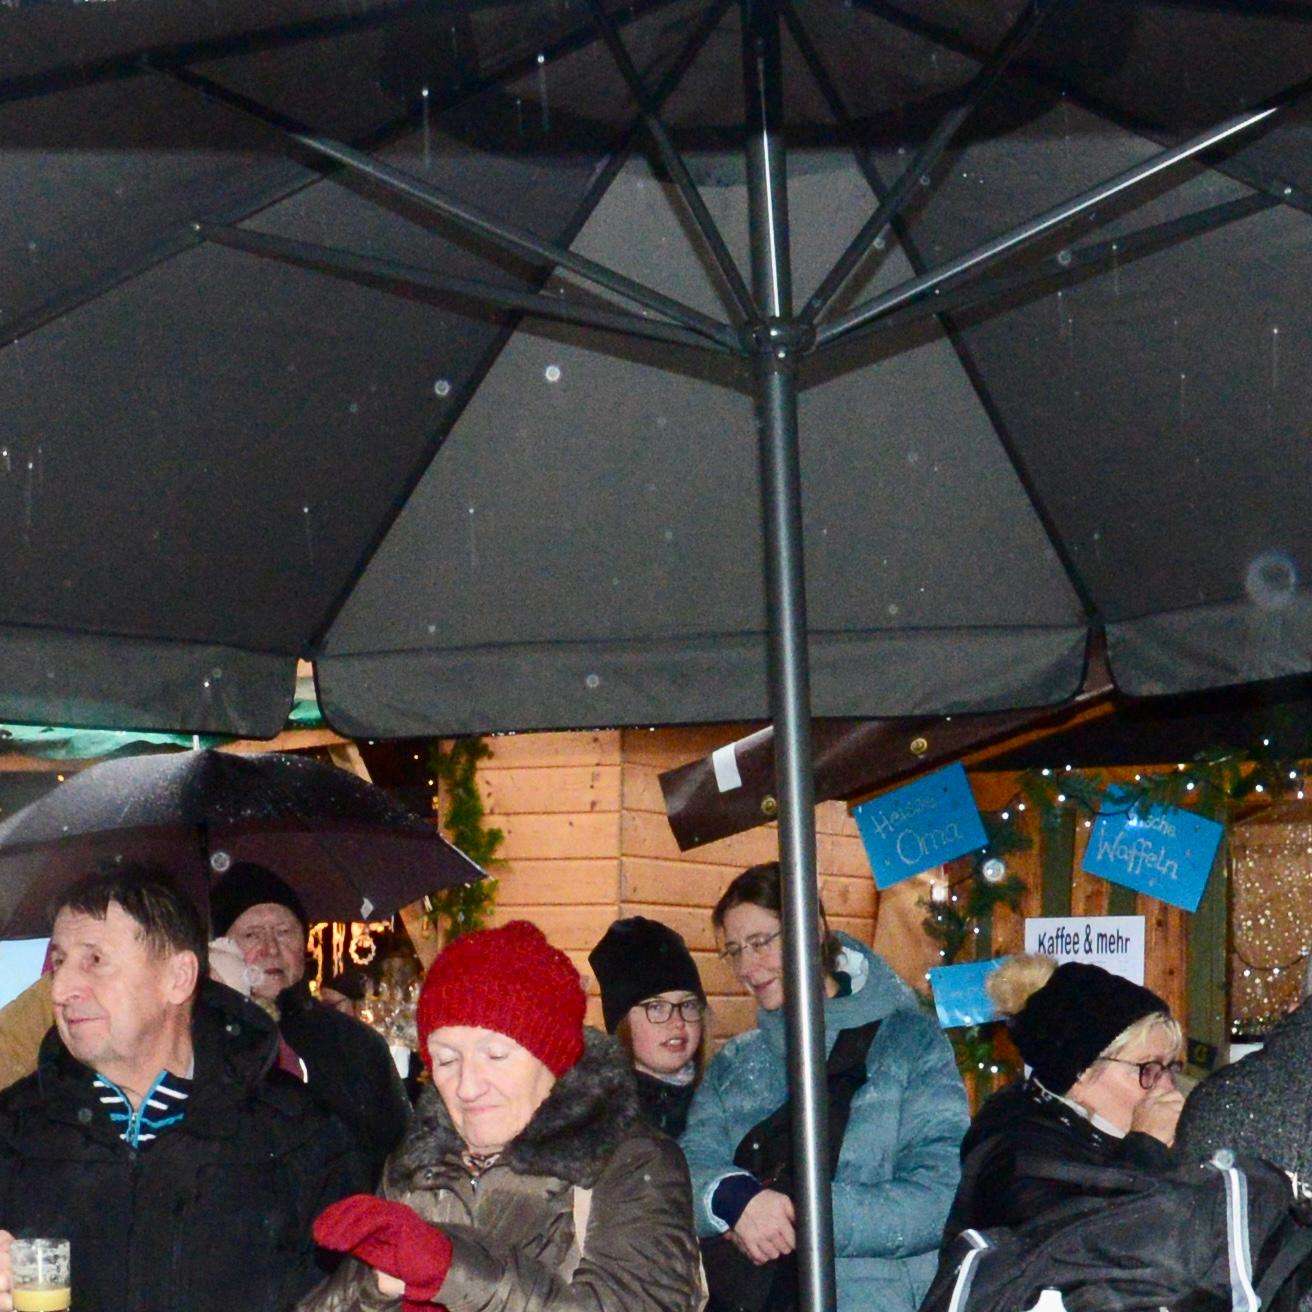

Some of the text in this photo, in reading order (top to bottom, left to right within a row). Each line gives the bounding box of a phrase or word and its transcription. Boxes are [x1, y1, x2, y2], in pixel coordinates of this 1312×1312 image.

[896, 822, 964, 865] Oma
[1096, 826, 1179, 880] Waffeln
[1038, 923, 1131, 956] Kaffee & mehr
